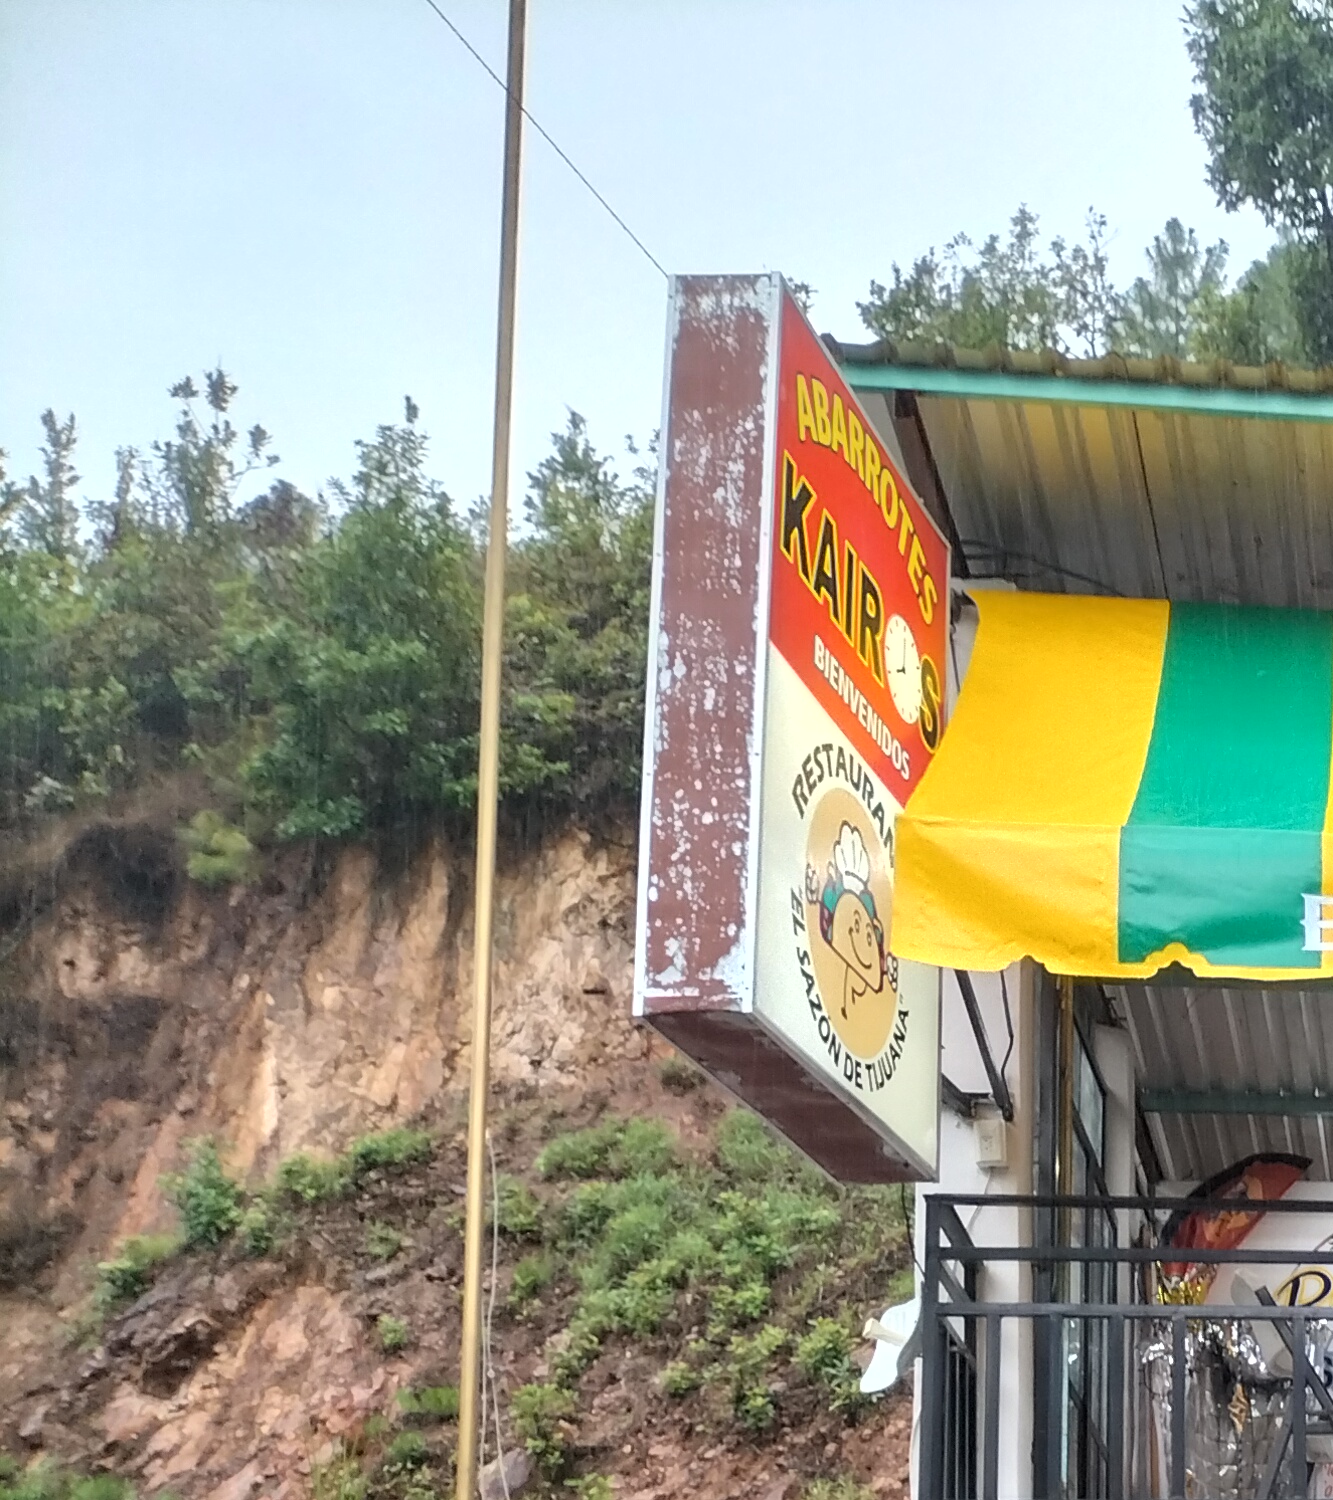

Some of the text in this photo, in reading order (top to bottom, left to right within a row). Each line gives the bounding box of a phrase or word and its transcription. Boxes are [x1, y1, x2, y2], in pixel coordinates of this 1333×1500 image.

[796, 373, 937, 625] ABARROTES
[814, 633, 910, 781] BIENVENIDOS
[843, 1051, 863, 1090] DE
